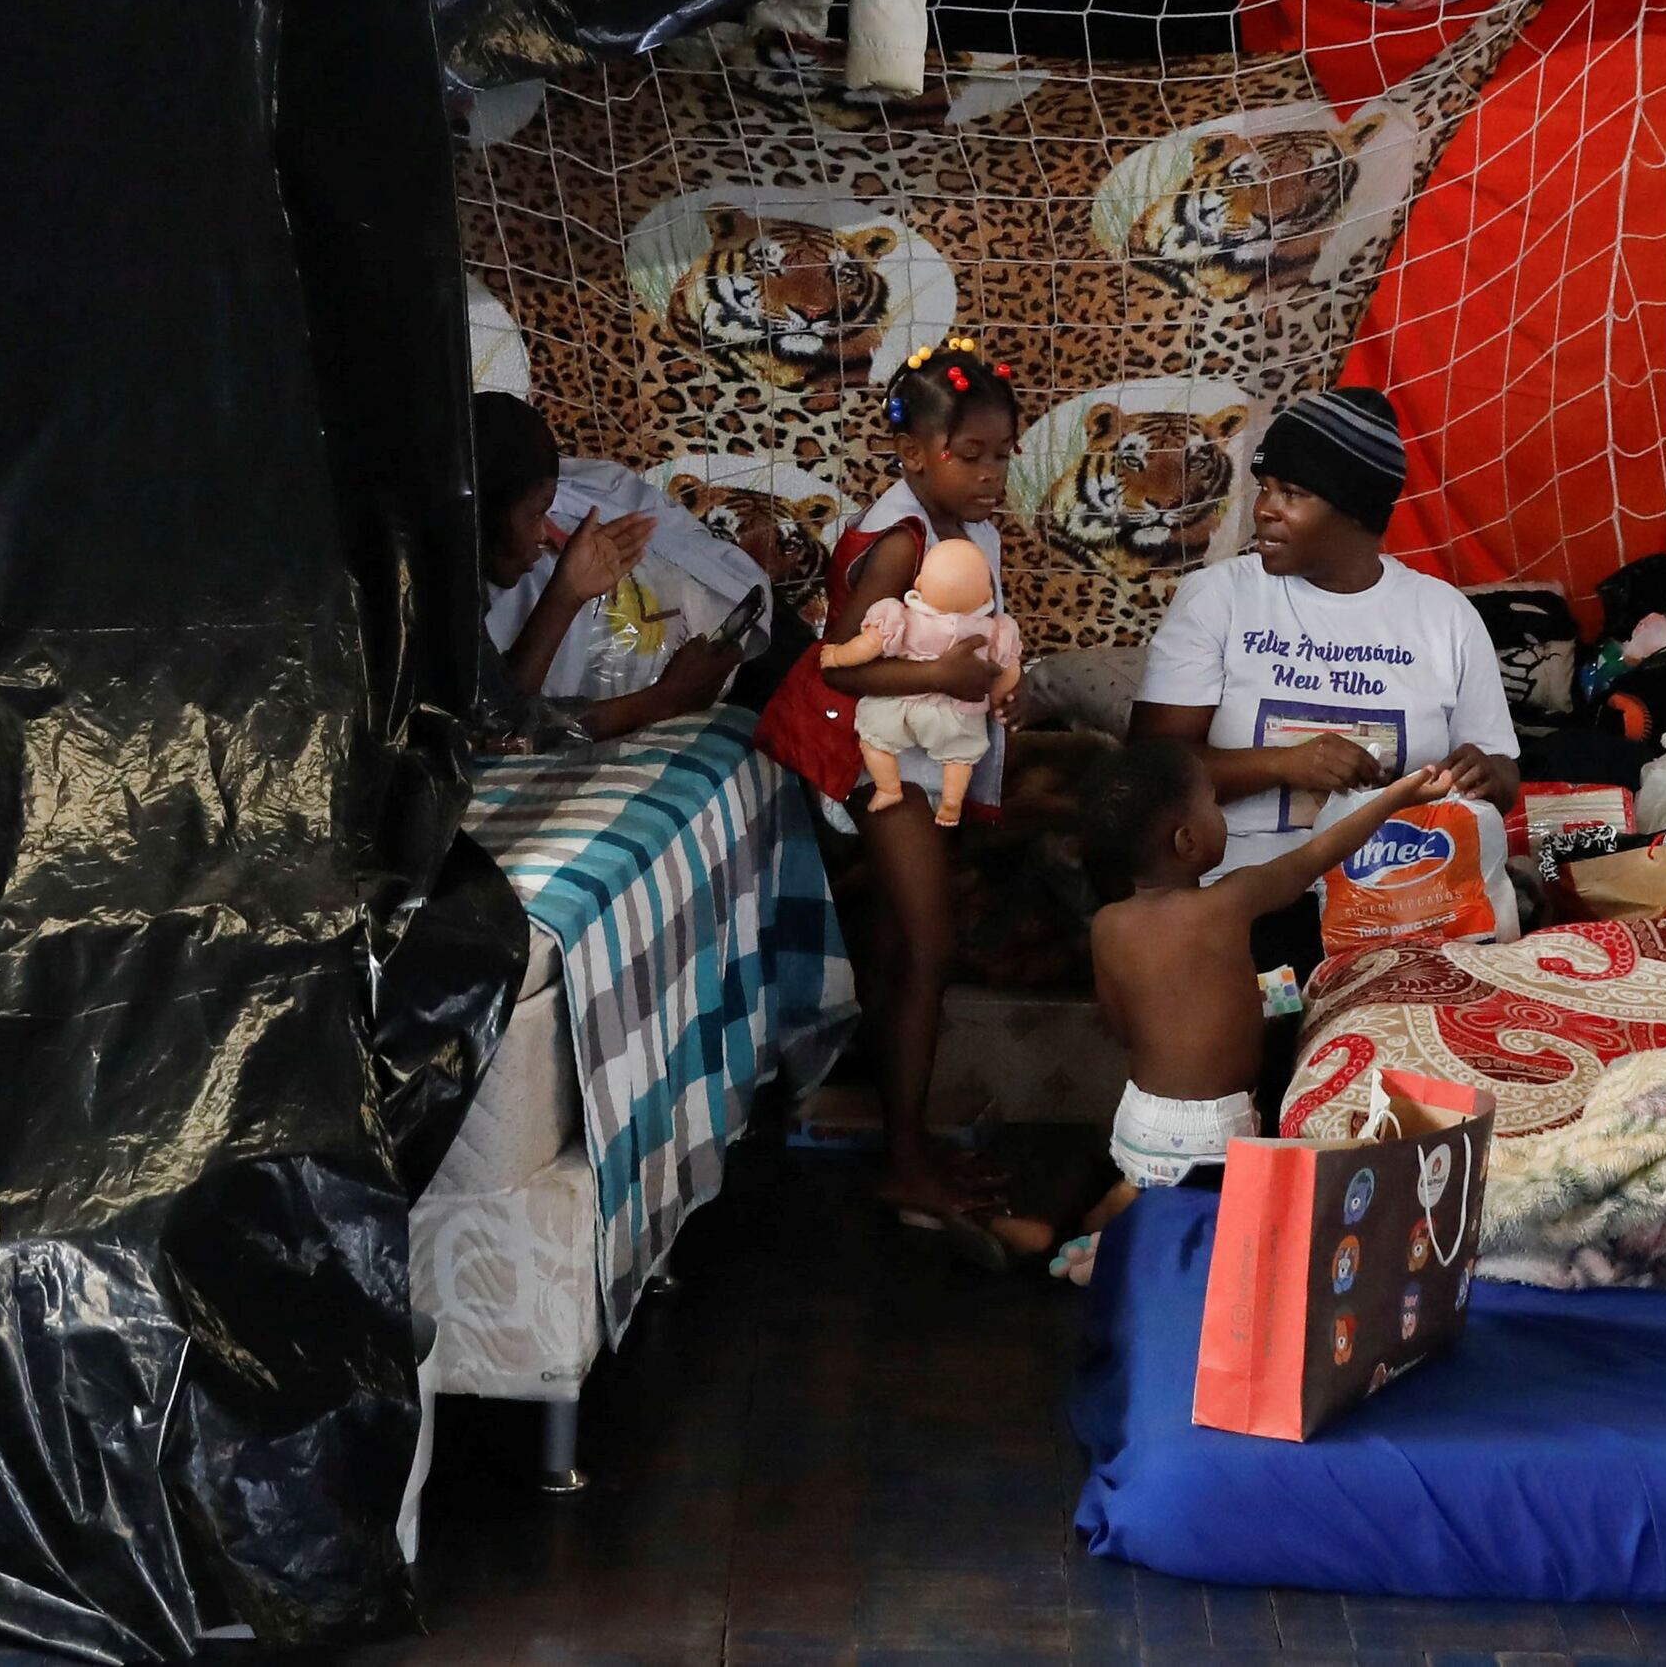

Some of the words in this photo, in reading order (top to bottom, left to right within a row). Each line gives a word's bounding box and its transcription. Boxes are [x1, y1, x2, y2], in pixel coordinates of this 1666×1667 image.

[1243, 629, 1291, 657] Feliz
[1295, 633, 1415, 666] Aniversário
[1272, 663, 1323, 691] Meu
[1329, 669, 1388, 696] Filho
[1345, 891, 1463, 918] SUPERMERCADOS
[1391, 920, 1422, 935] para
